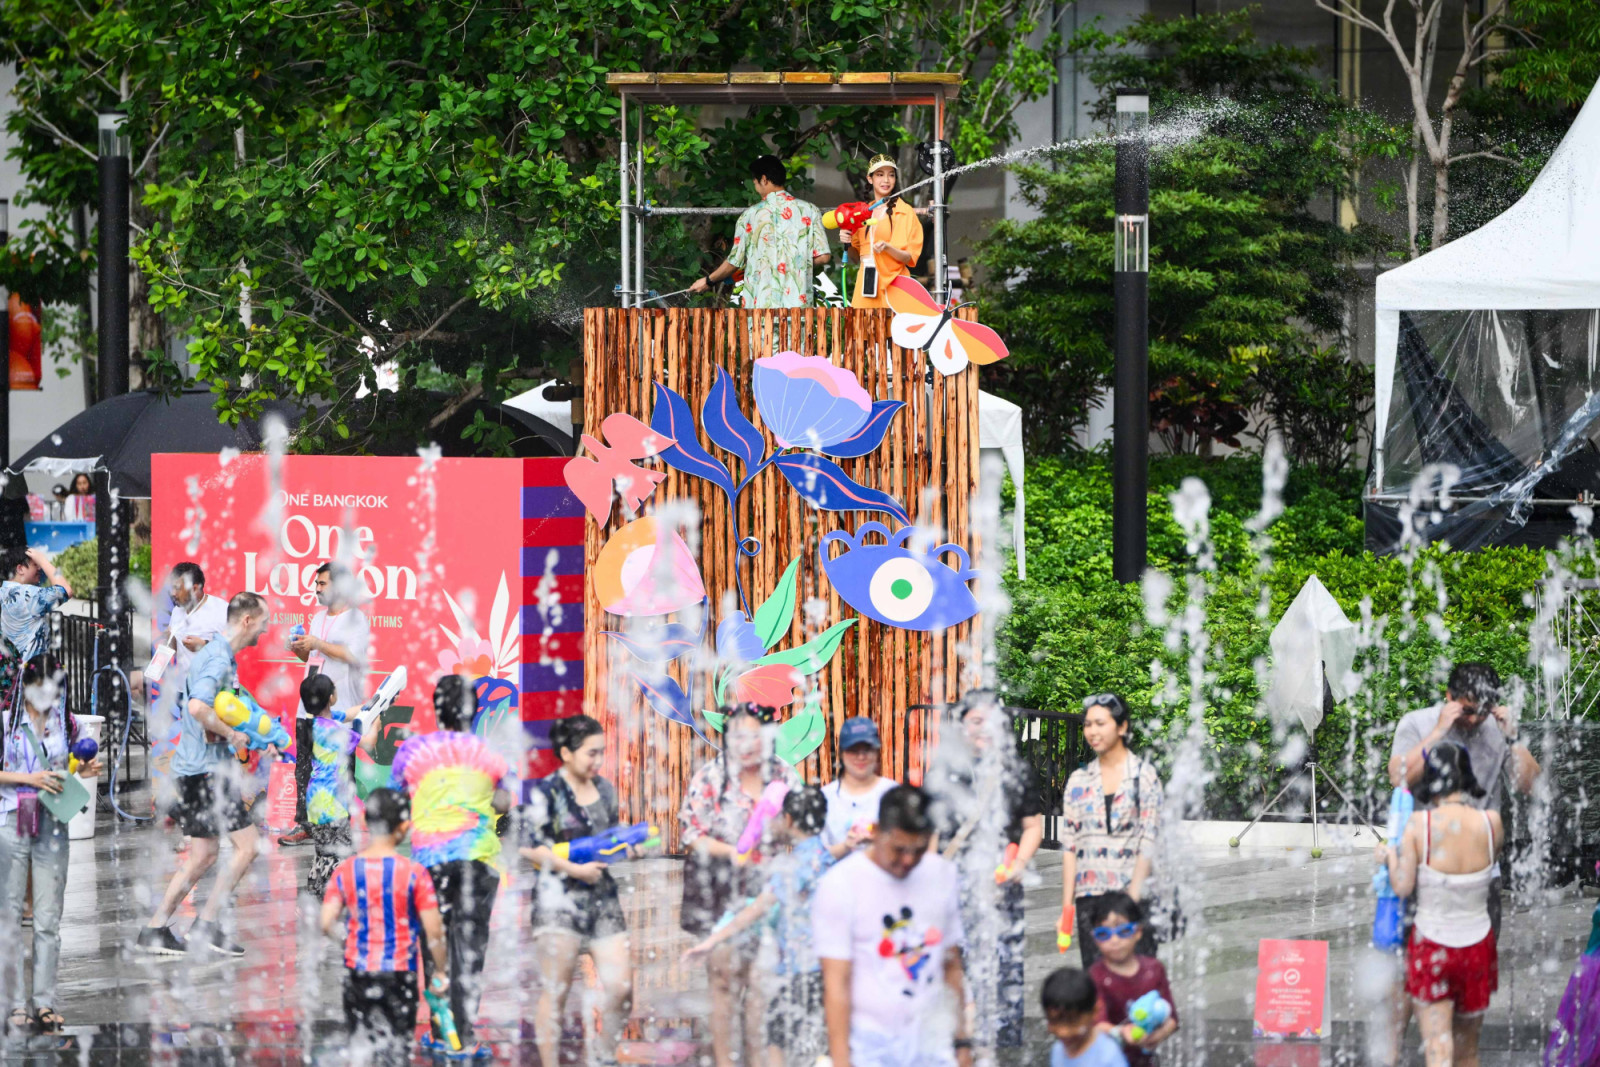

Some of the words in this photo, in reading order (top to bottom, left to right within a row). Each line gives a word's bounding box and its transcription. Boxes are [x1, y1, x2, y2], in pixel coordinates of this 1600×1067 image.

[275, 489, 309, 508] ONE
[313, 494, 389, 509] BANGKOK
[280, 514, 375, 560] One
[243, 551, 418, 607] Lagon
